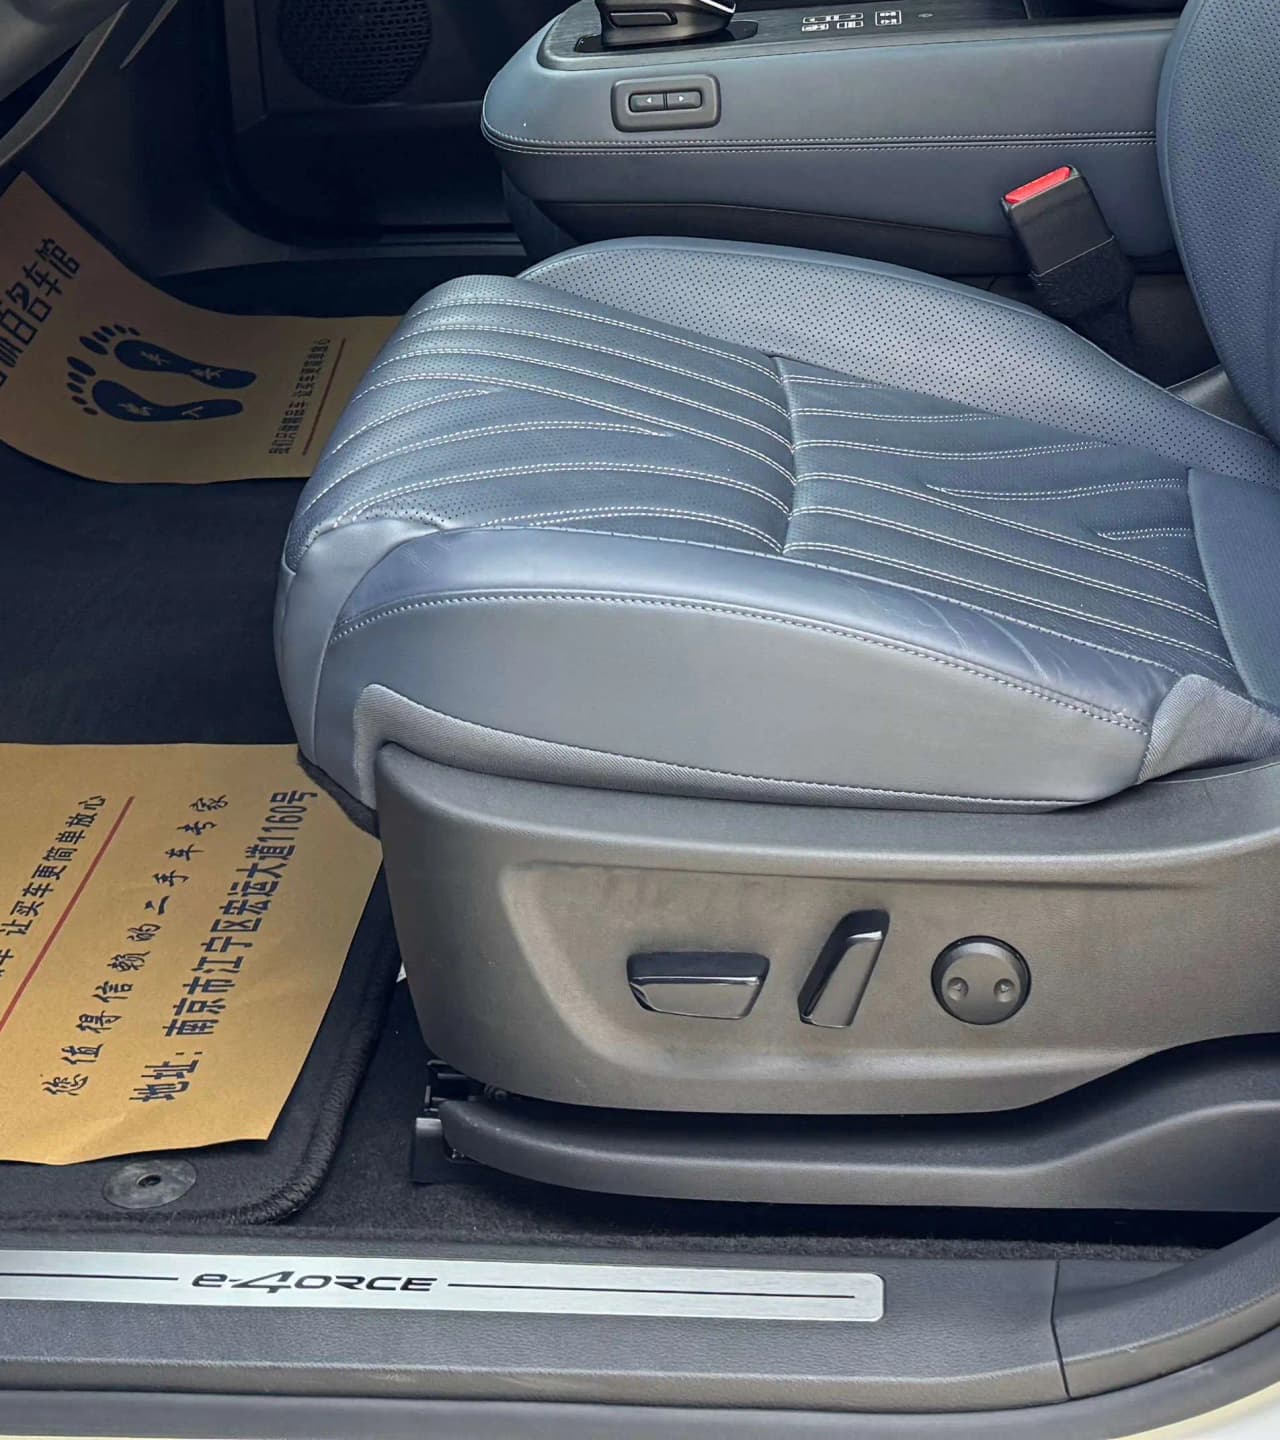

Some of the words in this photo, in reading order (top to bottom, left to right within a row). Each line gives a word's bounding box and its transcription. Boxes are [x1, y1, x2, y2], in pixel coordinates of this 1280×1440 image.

[42, 794, 229, 1097] 您值得信赖的二手车专家
